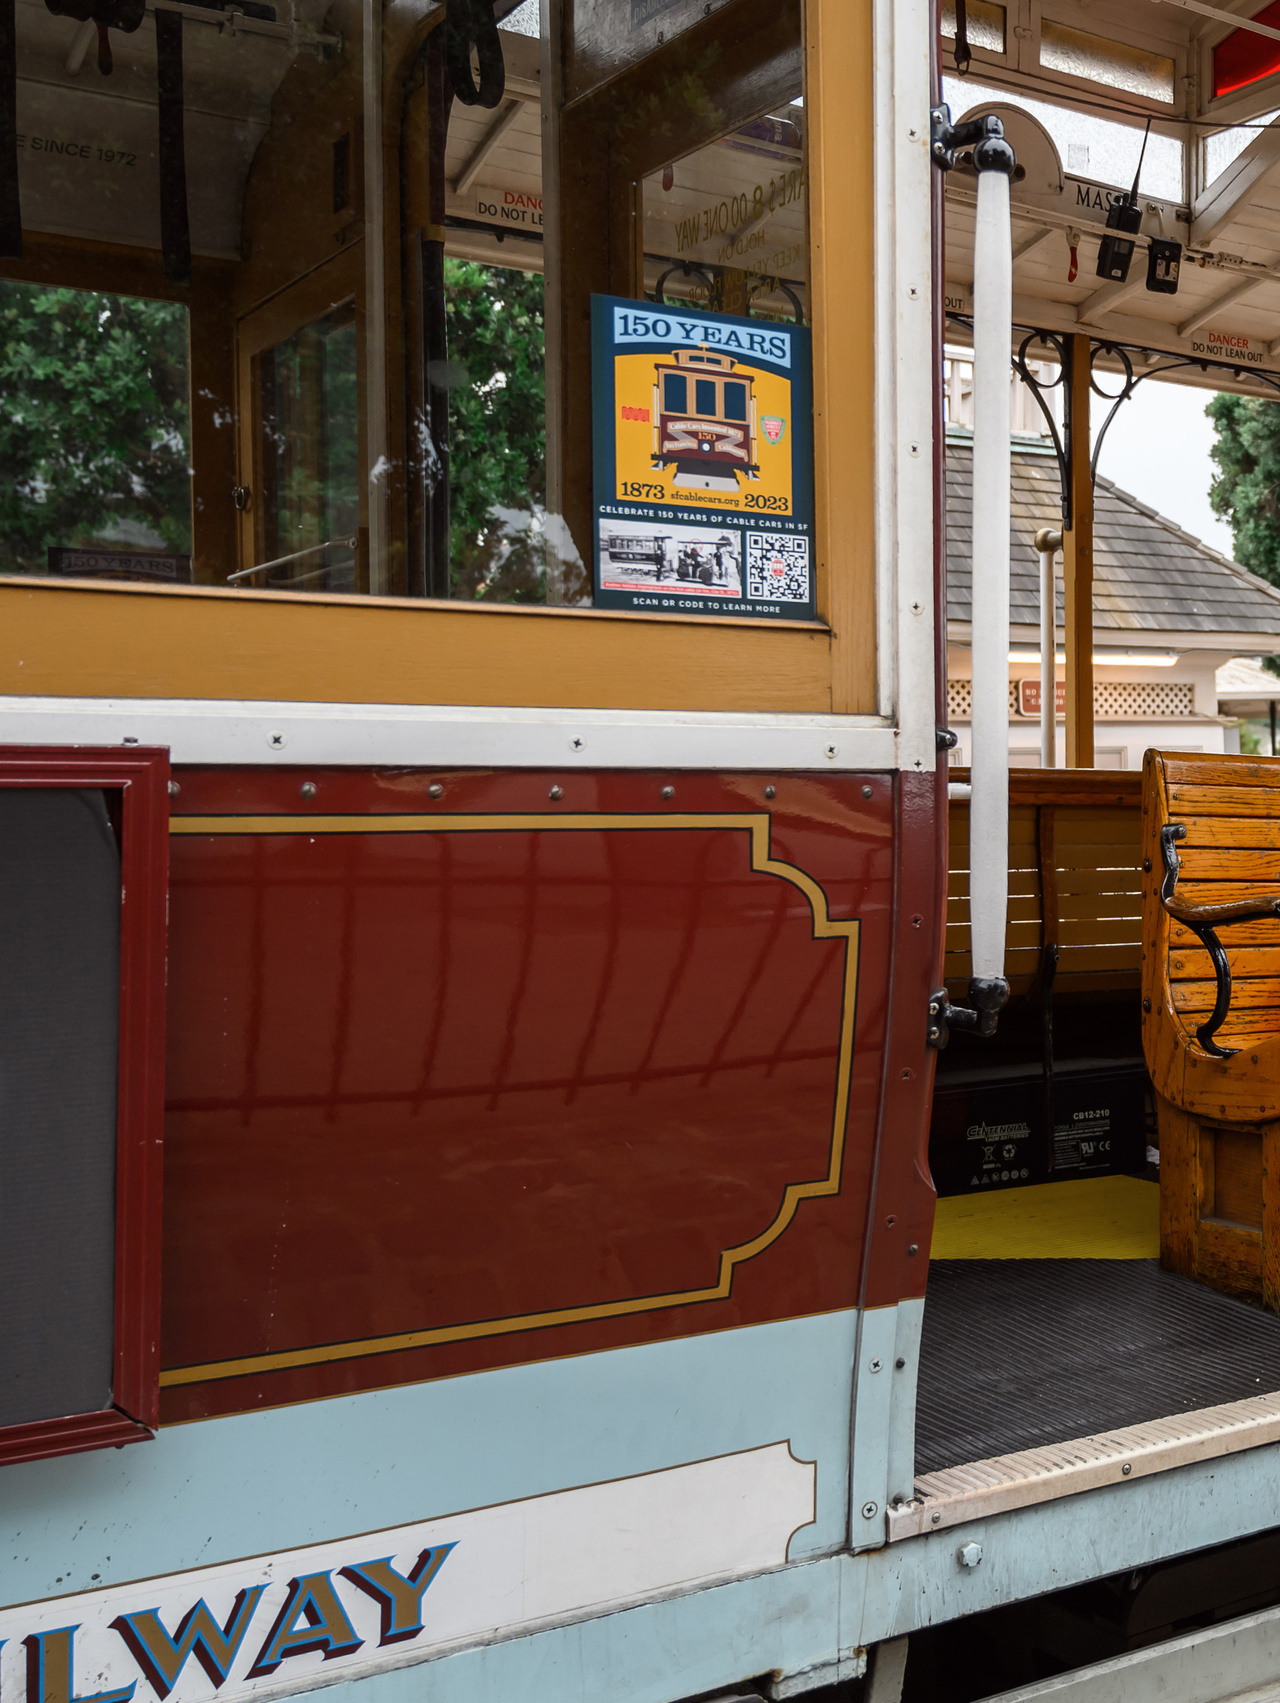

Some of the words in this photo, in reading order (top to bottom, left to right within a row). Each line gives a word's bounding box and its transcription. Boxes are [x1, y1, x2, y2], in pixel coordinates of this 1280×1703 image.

[30, 137, 92, 159] SINCE
[97, 148, 137, 167] 1972
[478, 202, 497, 216] DO
[501, 206, 528, 222] NOT
[619, 314, 672, 338] 150
[676, 322, 787, 360] YEARS
[1208, 332, 1249, 349] DANGER
[1192, 342, 1205, 353] DO
[1206, 344, 1223, 356] NOT
[1225, 347, 1246, 360] LEAN
[1247, 351, 1263, 363] OUT
[621, 482, 665, 500] 1873
[671, 491, 739, 507] sfcablecars.org
[744, 493, 789, 511] 2023
[599, 505, 655, 517] CELEBRATE
[658, 510, 674, 519] 150
[677, 512, 708, 522] YEARS
[710, 515, 723, 523] OF
[726, 517, 756, 526] CABLE
[759, 520, 782, 529] CARS
[785, 522, 795, 530] IN
[101, 558, 175, 574] YEARS
[632, 597, 659, 606] SCAN
[662, 599, 676, 607] QR
[678, 600, 704, 609] CODE
[707, 602, 720, 610] TO
[723, 603, 753, 612] LEARN
[756, 605, 781, 614] MORE
[1073, 1109, 1110, 1120] CB12-210
[967, 1121, 1029, 1142] CENTENNIAL
[0, 1540, 461, 1703] LWAY
